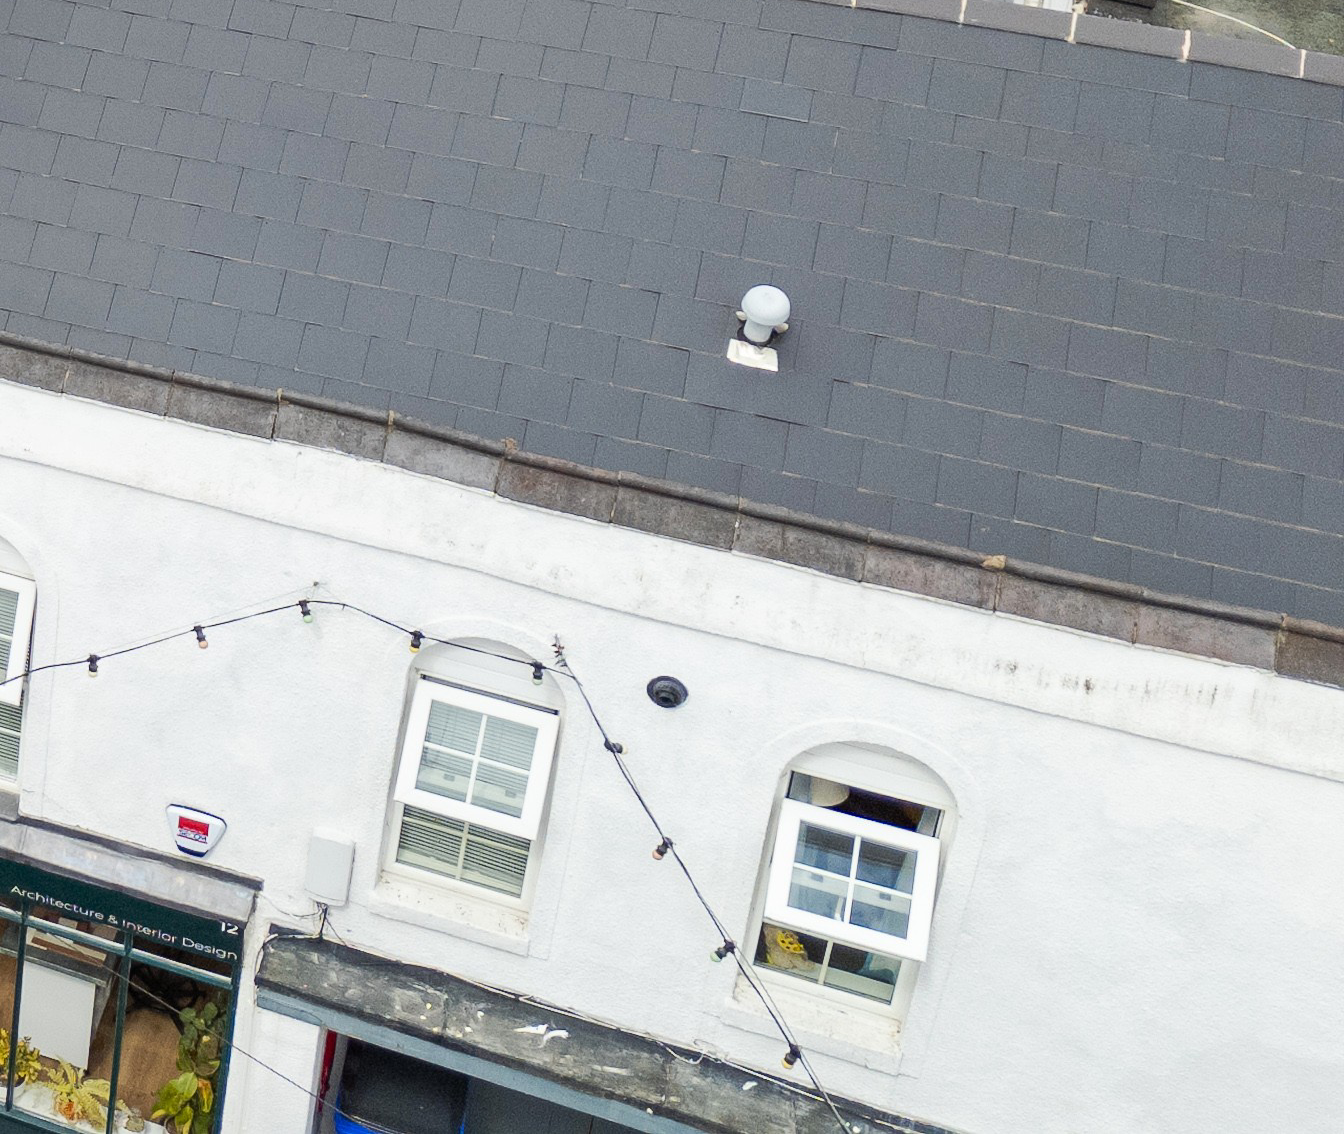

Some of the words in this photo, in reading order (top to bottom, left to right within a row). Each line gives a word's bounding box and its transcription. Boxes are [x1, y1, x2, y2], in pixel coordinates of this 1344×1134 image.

[11, 885, 105, 921] Architecture
[108, 914, 119, 925] &
[122, 919, 178, 943] Interior
[182, 937, 238, 961] Design
[219, 921, 239, 936] 12
